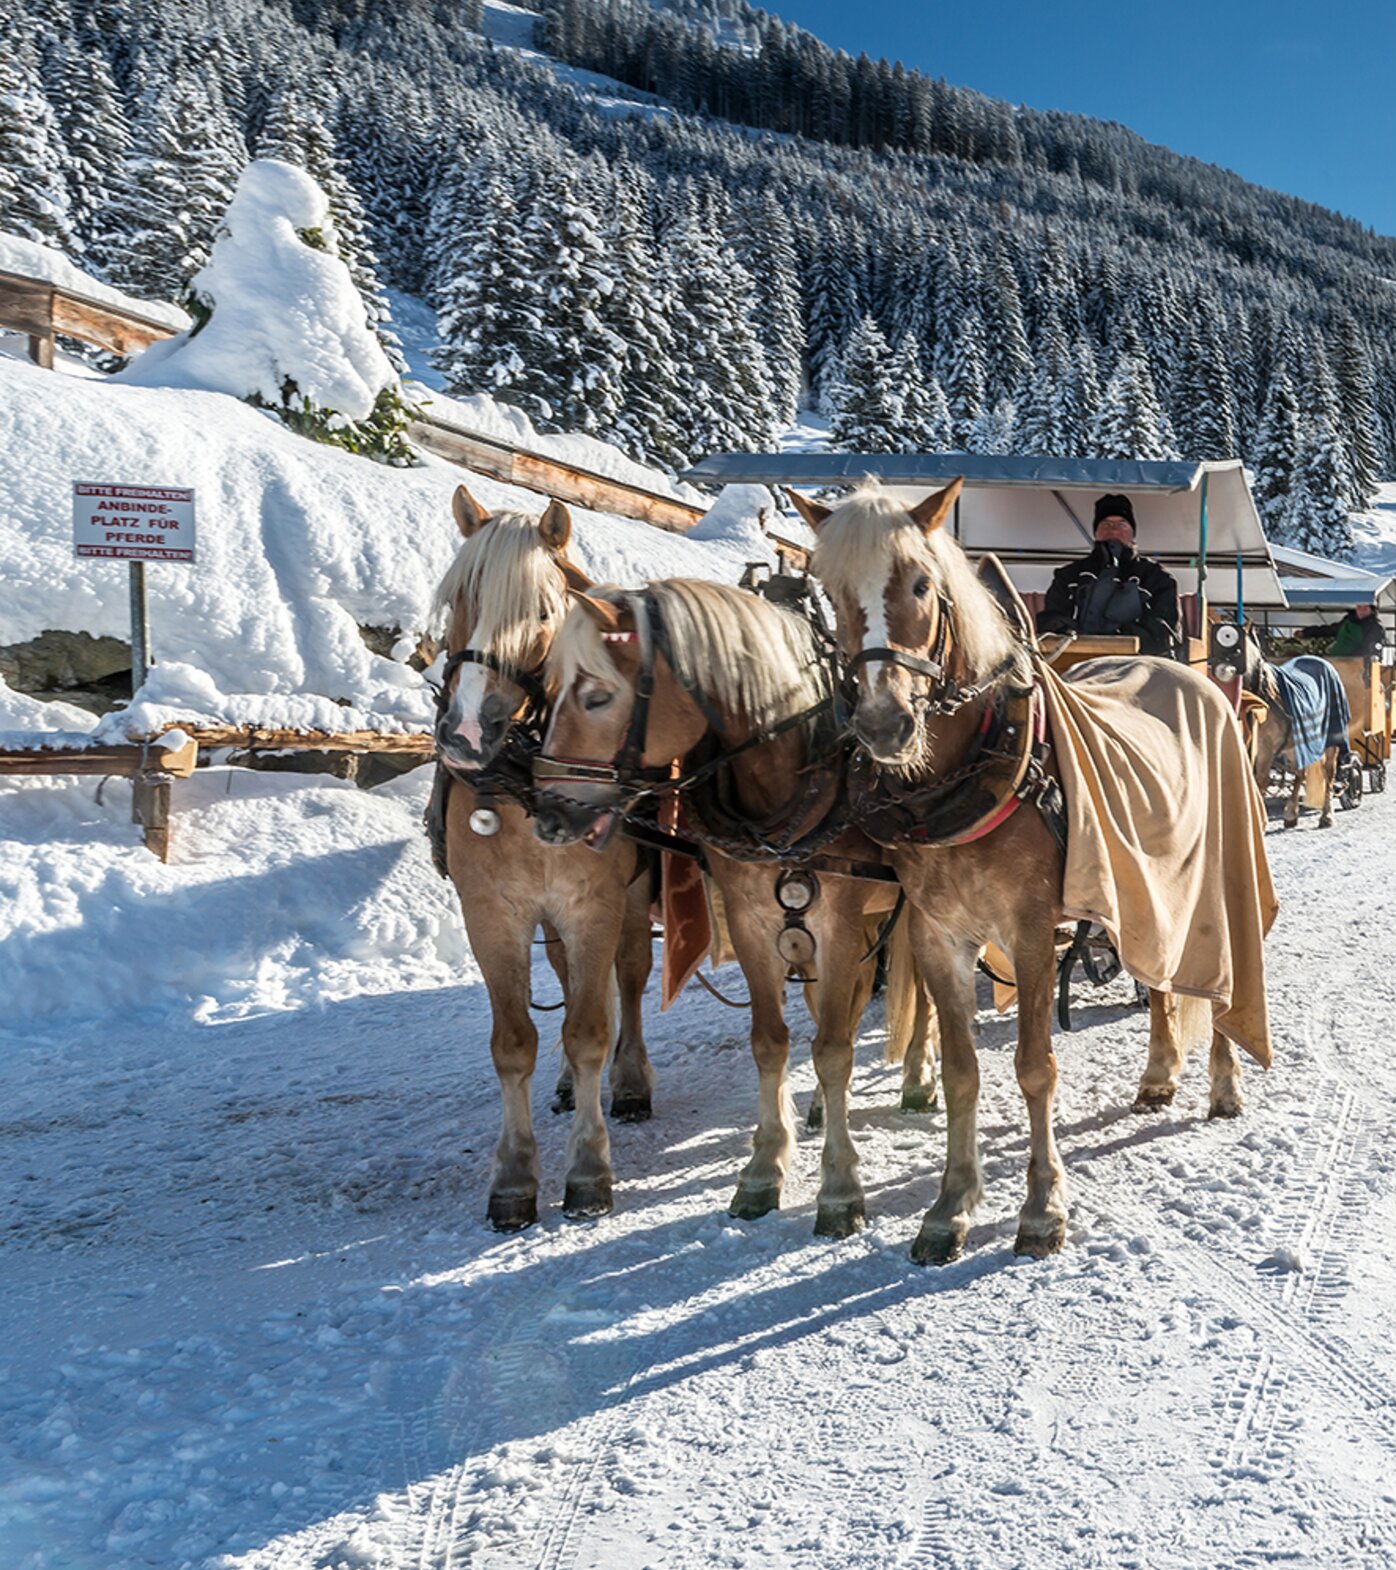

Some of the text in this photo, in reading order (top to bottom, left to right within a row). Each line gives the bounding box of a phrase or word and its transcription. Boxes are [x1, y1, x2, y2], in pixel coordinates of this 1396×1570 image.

[78, 485, 113, 496] BITTE
[97, 501, 172, 514] ANBINDE-
[91, 516, 179, 529] PLATZ FÜR
[105, 532, 166, 544] PFERDE
[78, 546, 113, 556] BITTE
